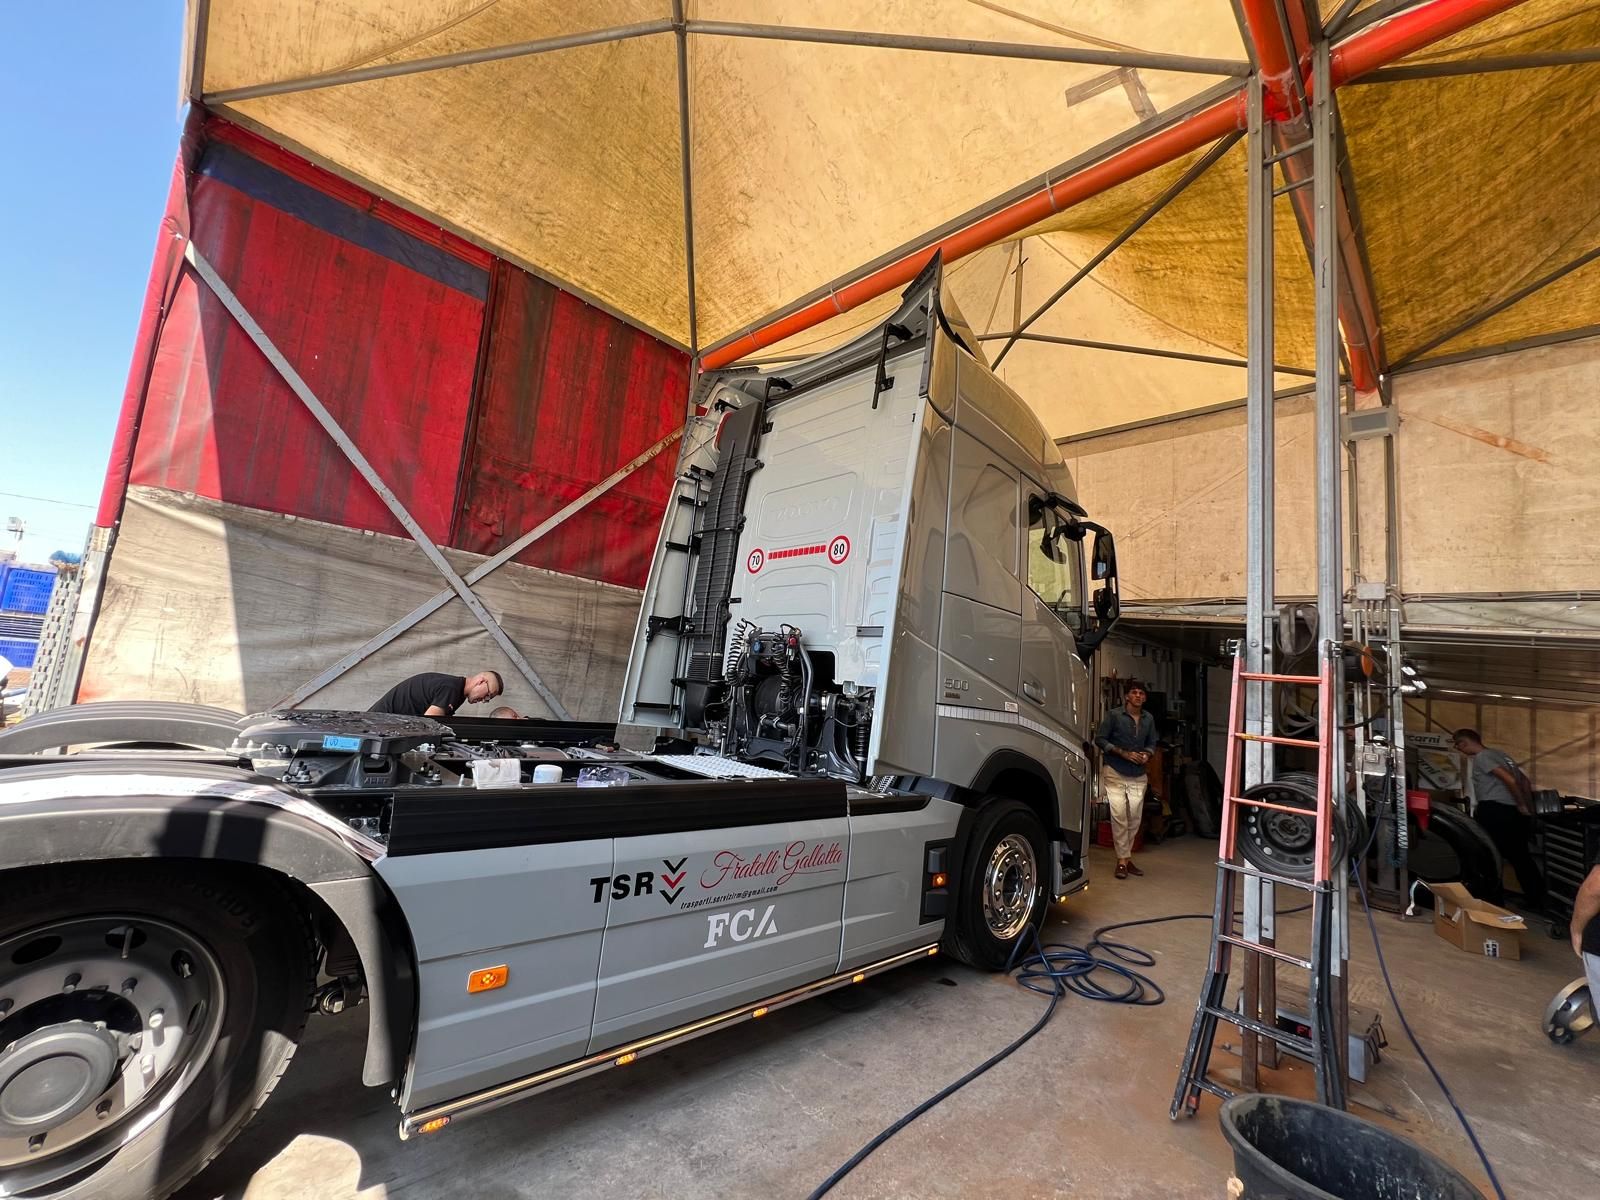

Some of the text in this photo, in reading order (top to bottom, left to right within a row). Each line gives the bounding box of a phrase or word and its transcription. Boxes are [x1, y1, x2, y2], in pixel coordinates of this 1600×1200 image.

[751, 555, 761, 566] 70
[833, 543, 845, 556] 80
[700, 840, 843, 888] Fratelli Gallotta
[590, 871, 655, 904] TSR
[703, 904, 778, 949] FCA
